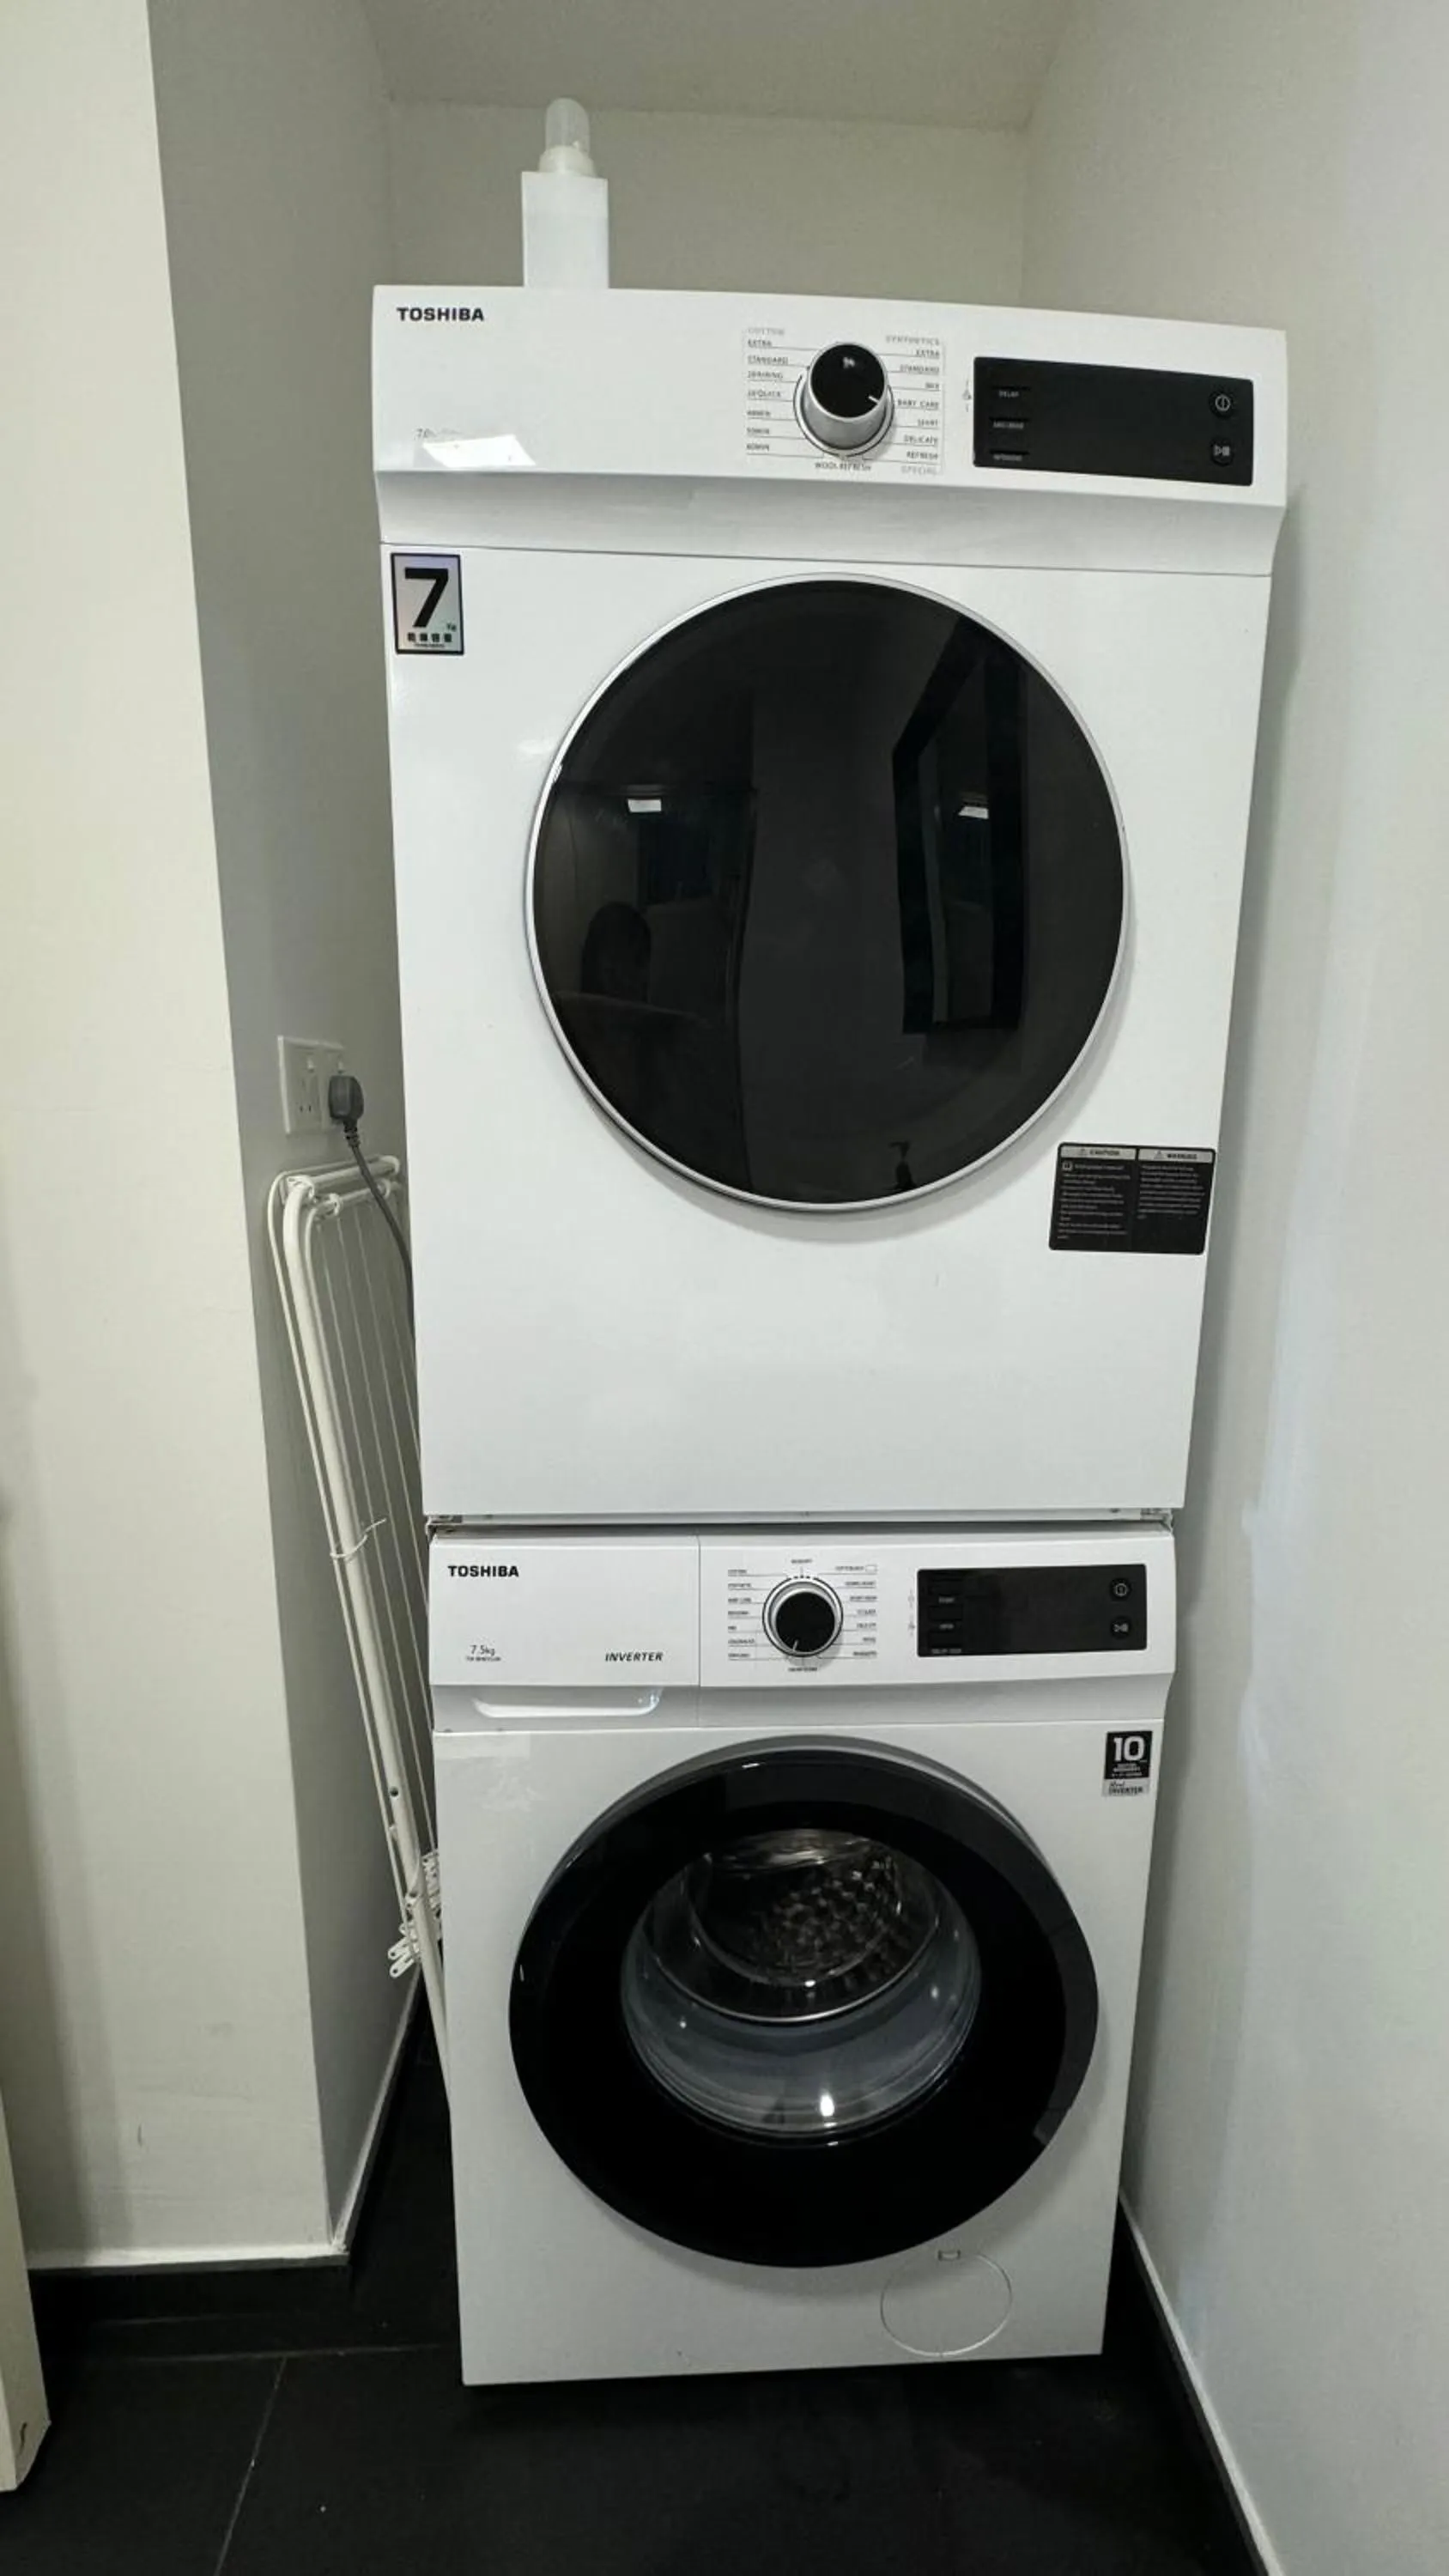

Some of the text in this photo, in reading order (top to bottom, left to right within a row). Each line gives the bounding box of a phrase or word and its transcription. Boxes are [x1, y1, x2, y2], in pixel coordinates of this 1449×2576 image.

[397, 307, 485, 322] TOSHIBA
[405, 568, 449, 628] 7
[448, 1565, 519, 1578] TOSHIBA
[604, 1651, 664, 1662] INVERTER
[1113, 1735, 1145, 1762] 10
